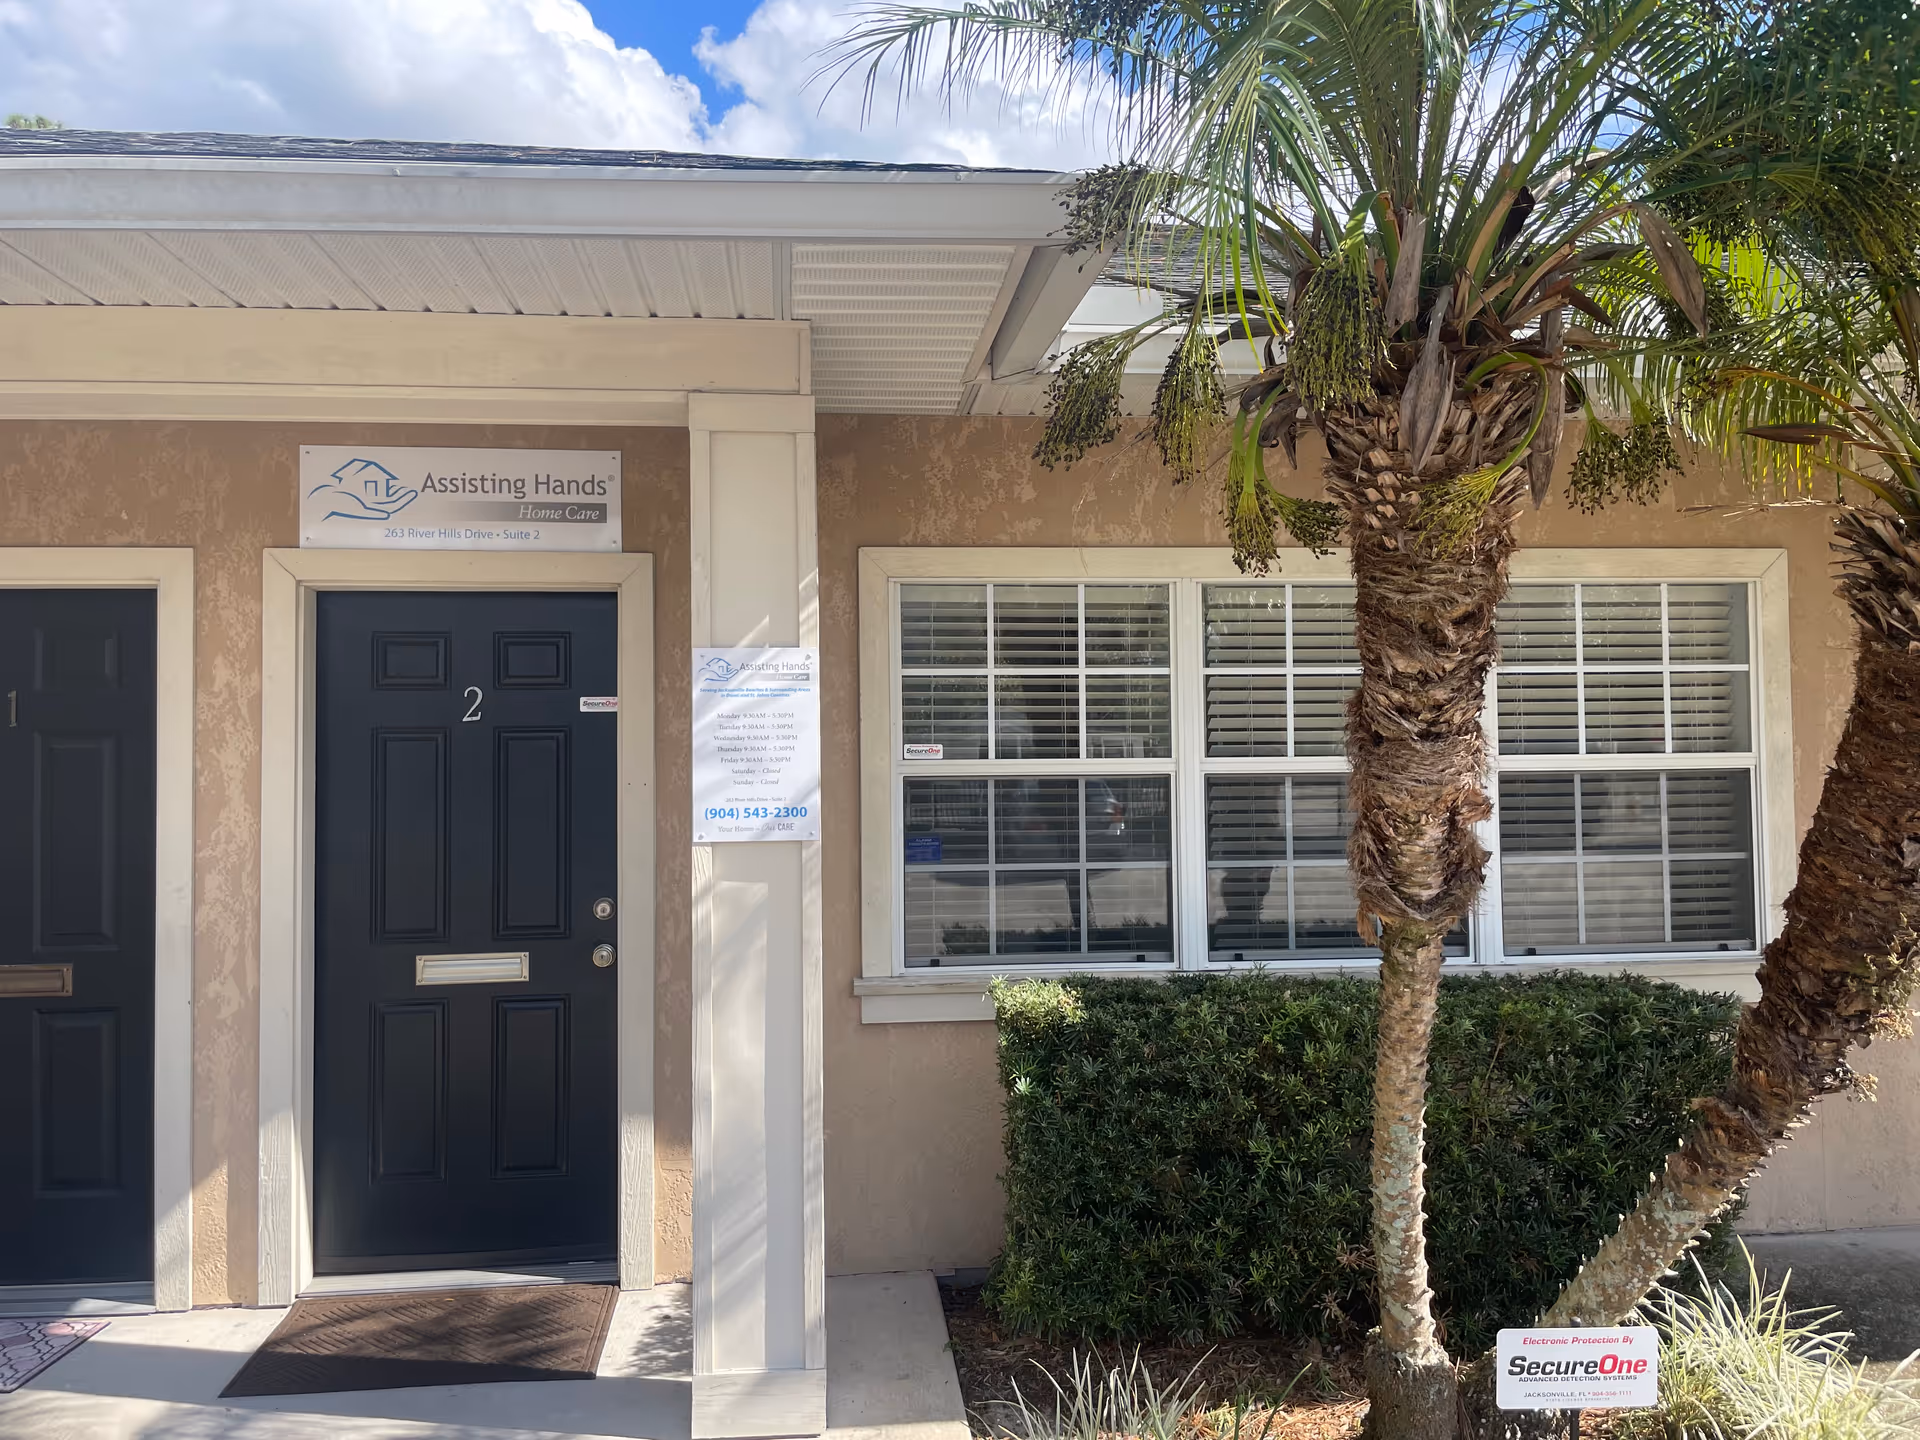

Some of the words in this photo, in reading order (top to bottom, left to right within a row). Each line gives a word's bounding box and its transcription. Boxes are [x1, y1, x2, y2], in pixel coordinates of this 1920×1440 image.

[421, 472, 526, 499] Assisting
[518, 505, 562, 519] Home
[565, 505, 599, 520] Care
[384, 528, 405, 538] 263
[408, 528, 435, 538] River
[438, 528, 461, 539] Hills
[464, 529, 494, 539] Drive
[503, 529, 531, 540] Suite
[533, 530, 540, 540] 2
[740, 662, 779, 672] Assisting
[462, 686, 483, 722] 2
[717, 711, 740, 719] Monday
[704, 807, 740, 820] (904)
[743, 807, 808, 818] 543-2300
[777, 822, 795, 831] CARE
[1523, 1337, 1569, 1345] Electronic
[1571, 1336, 1619, 1344] Protection
[1622, 1336, 1634, 1345] By
[1508, 1354, 1648, 1376] SecureOne
